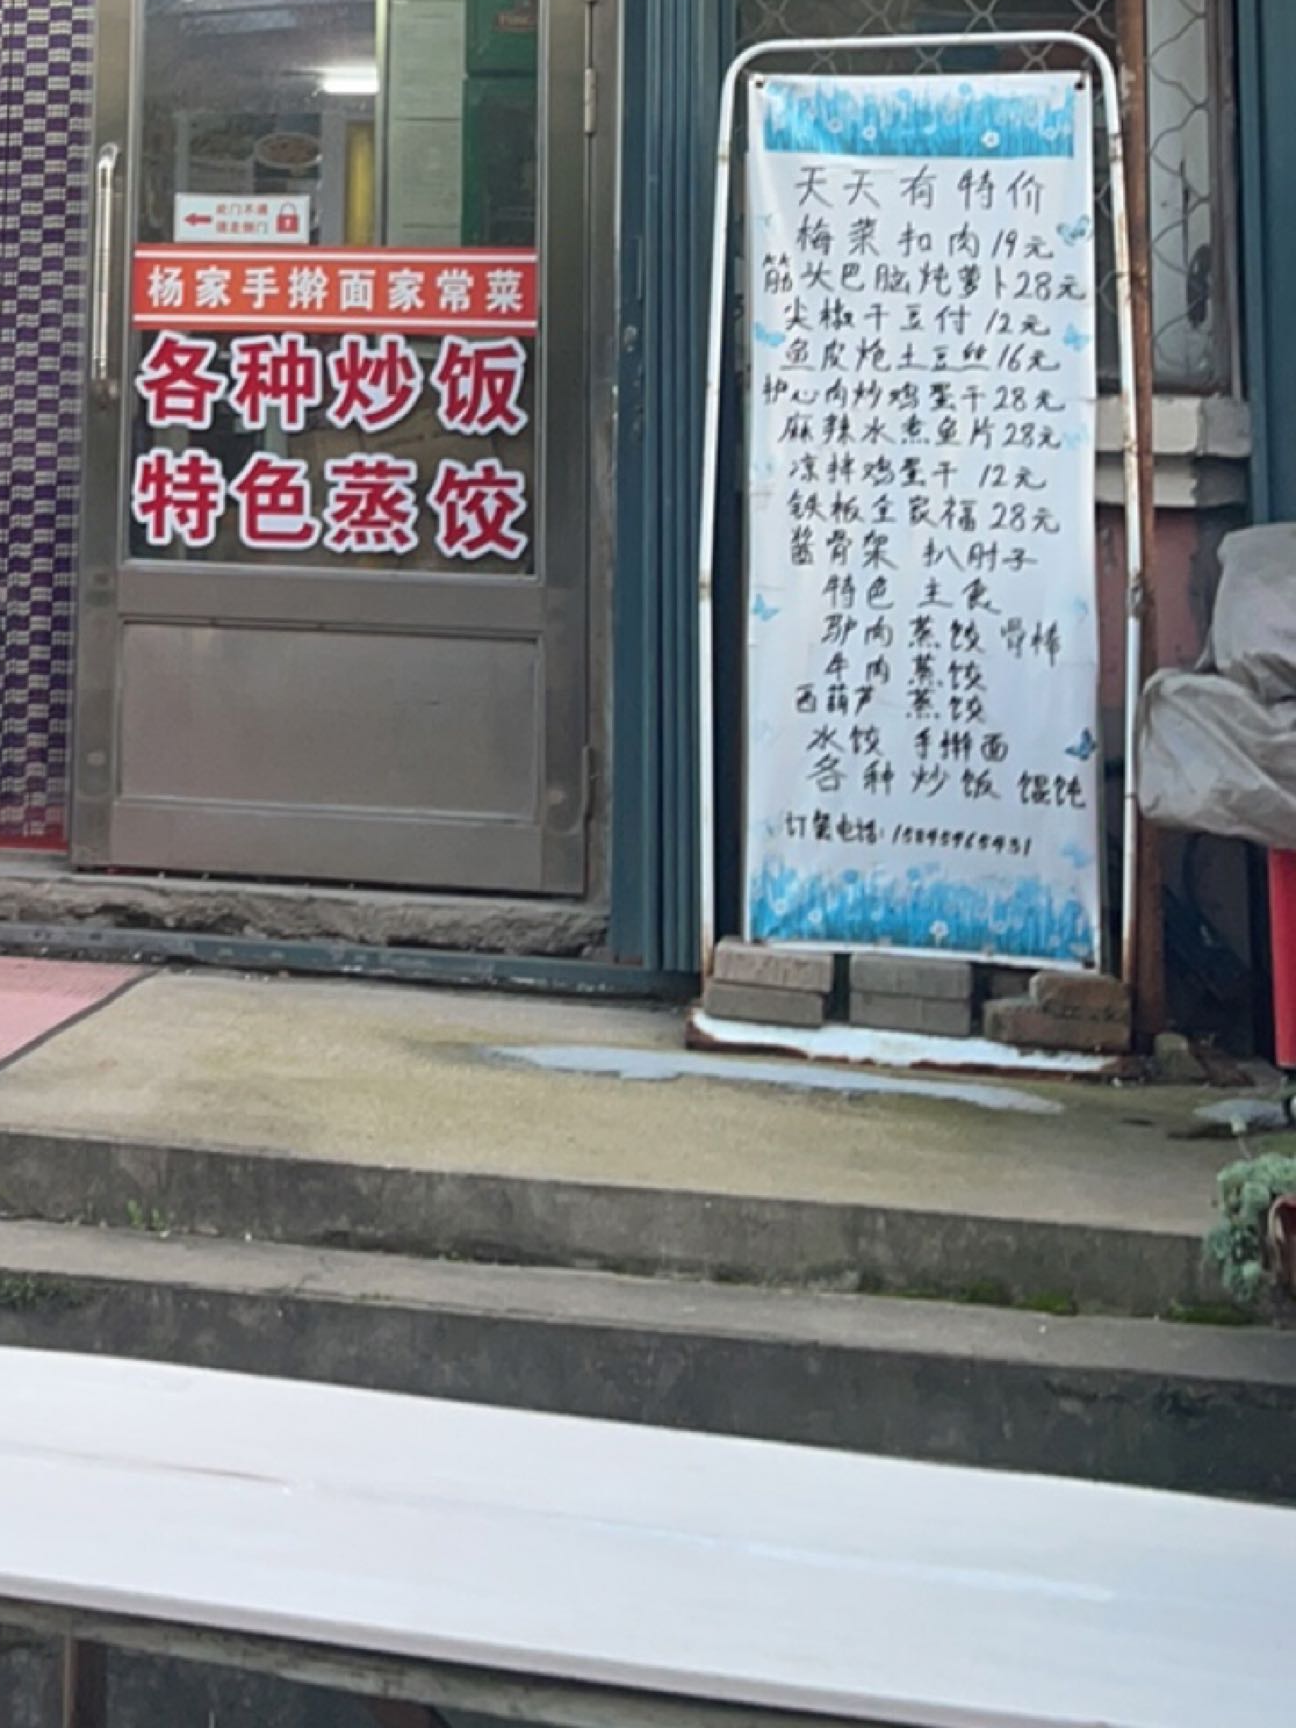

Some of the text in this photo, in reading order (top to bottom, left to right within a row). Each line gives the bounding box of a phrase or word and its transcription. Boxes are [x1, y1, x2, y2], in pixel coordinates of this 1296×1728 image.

[795, 163, 1046, 214] 天天有特价
[147, 263, 524, 313] 杨家手擀面家常菜
[136, 330, 528, 434] 各种炒饭
[134, 449, 528, 558] 特色蒸饺
